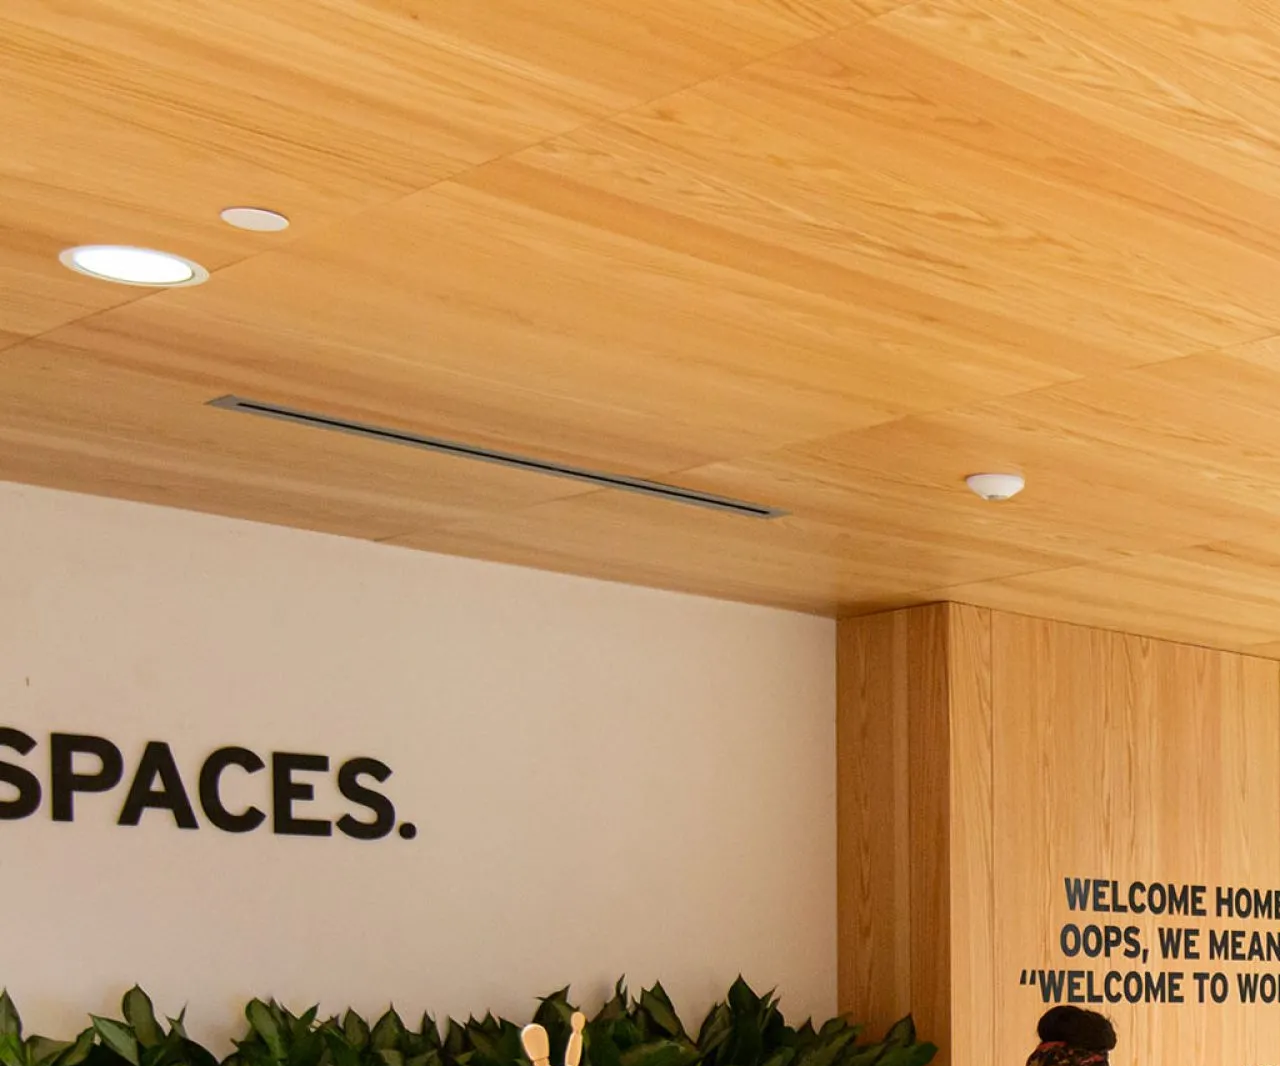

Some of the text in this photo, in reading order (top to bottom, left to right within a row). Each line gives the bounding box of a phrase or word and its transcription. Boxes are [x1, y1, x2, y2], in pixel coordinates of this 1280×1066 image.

[0, 726, 417, 840] SPACES.
[1064, 877, 1207, 916] WELCOME
[1060, 923, 1149, 963] OOPS,
[1158, 927, 1200, 960] WE
[1192, 972, 1229, 1004] TO
